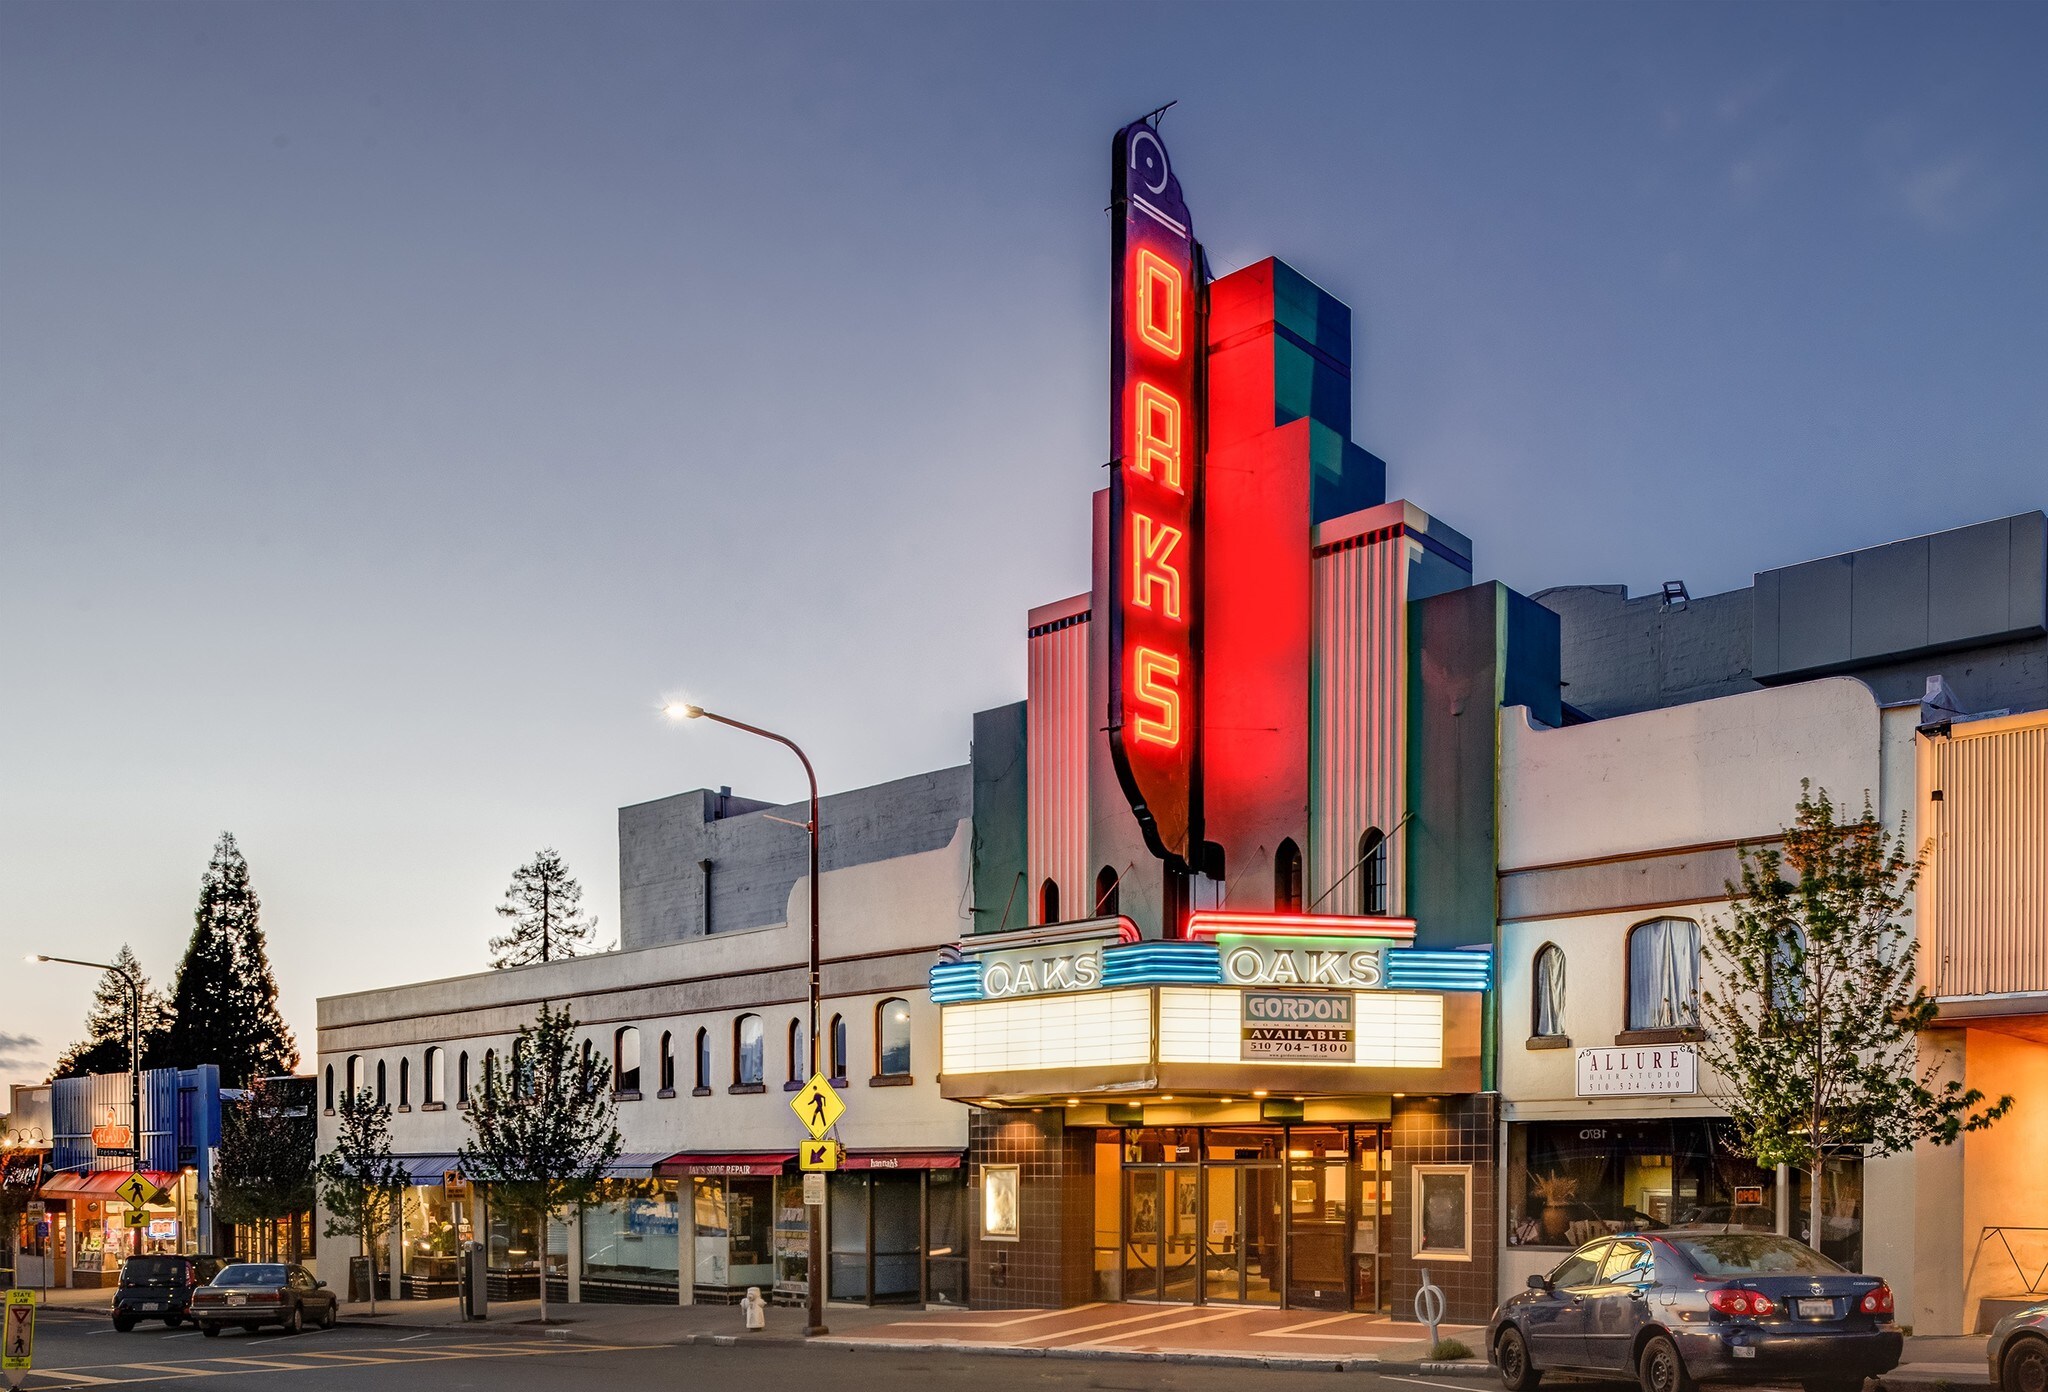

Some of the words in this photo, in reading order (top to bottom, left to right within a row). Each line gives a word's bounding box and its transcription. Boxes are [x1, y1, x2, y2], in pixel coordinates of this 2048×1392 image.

[1130, 246, 1184, 750] OAKS
[1226, 946, 1382, 986] OAKS
[984, 950, 1100, 997] OAKS
[1249, 998, 1348, 1020] GORDON
[1251, 1029, 1347, 1040] AVAILABLE
[1250, 1042, 1271, 1052] 510
[1275, 1043, 1347, 1052] 704-1800
[1590, 1051, 1680, 1071] ALLURE
[1589, 1073, 1619, 1081] HAIR
[1629, 1071, 1680, 1080] STUDIO
[1589, 1080, 1680, 1091] 510.524.6200
[96, 1127, 126, 1144] PEGASUS
[870, 1157, 898, 1169] hannah's
[706, 1165, 725, 1175] SHOE
[726, 1165, 751, 1175] REPAIR
[1737, 1190, 1760, 1202] OPEN
